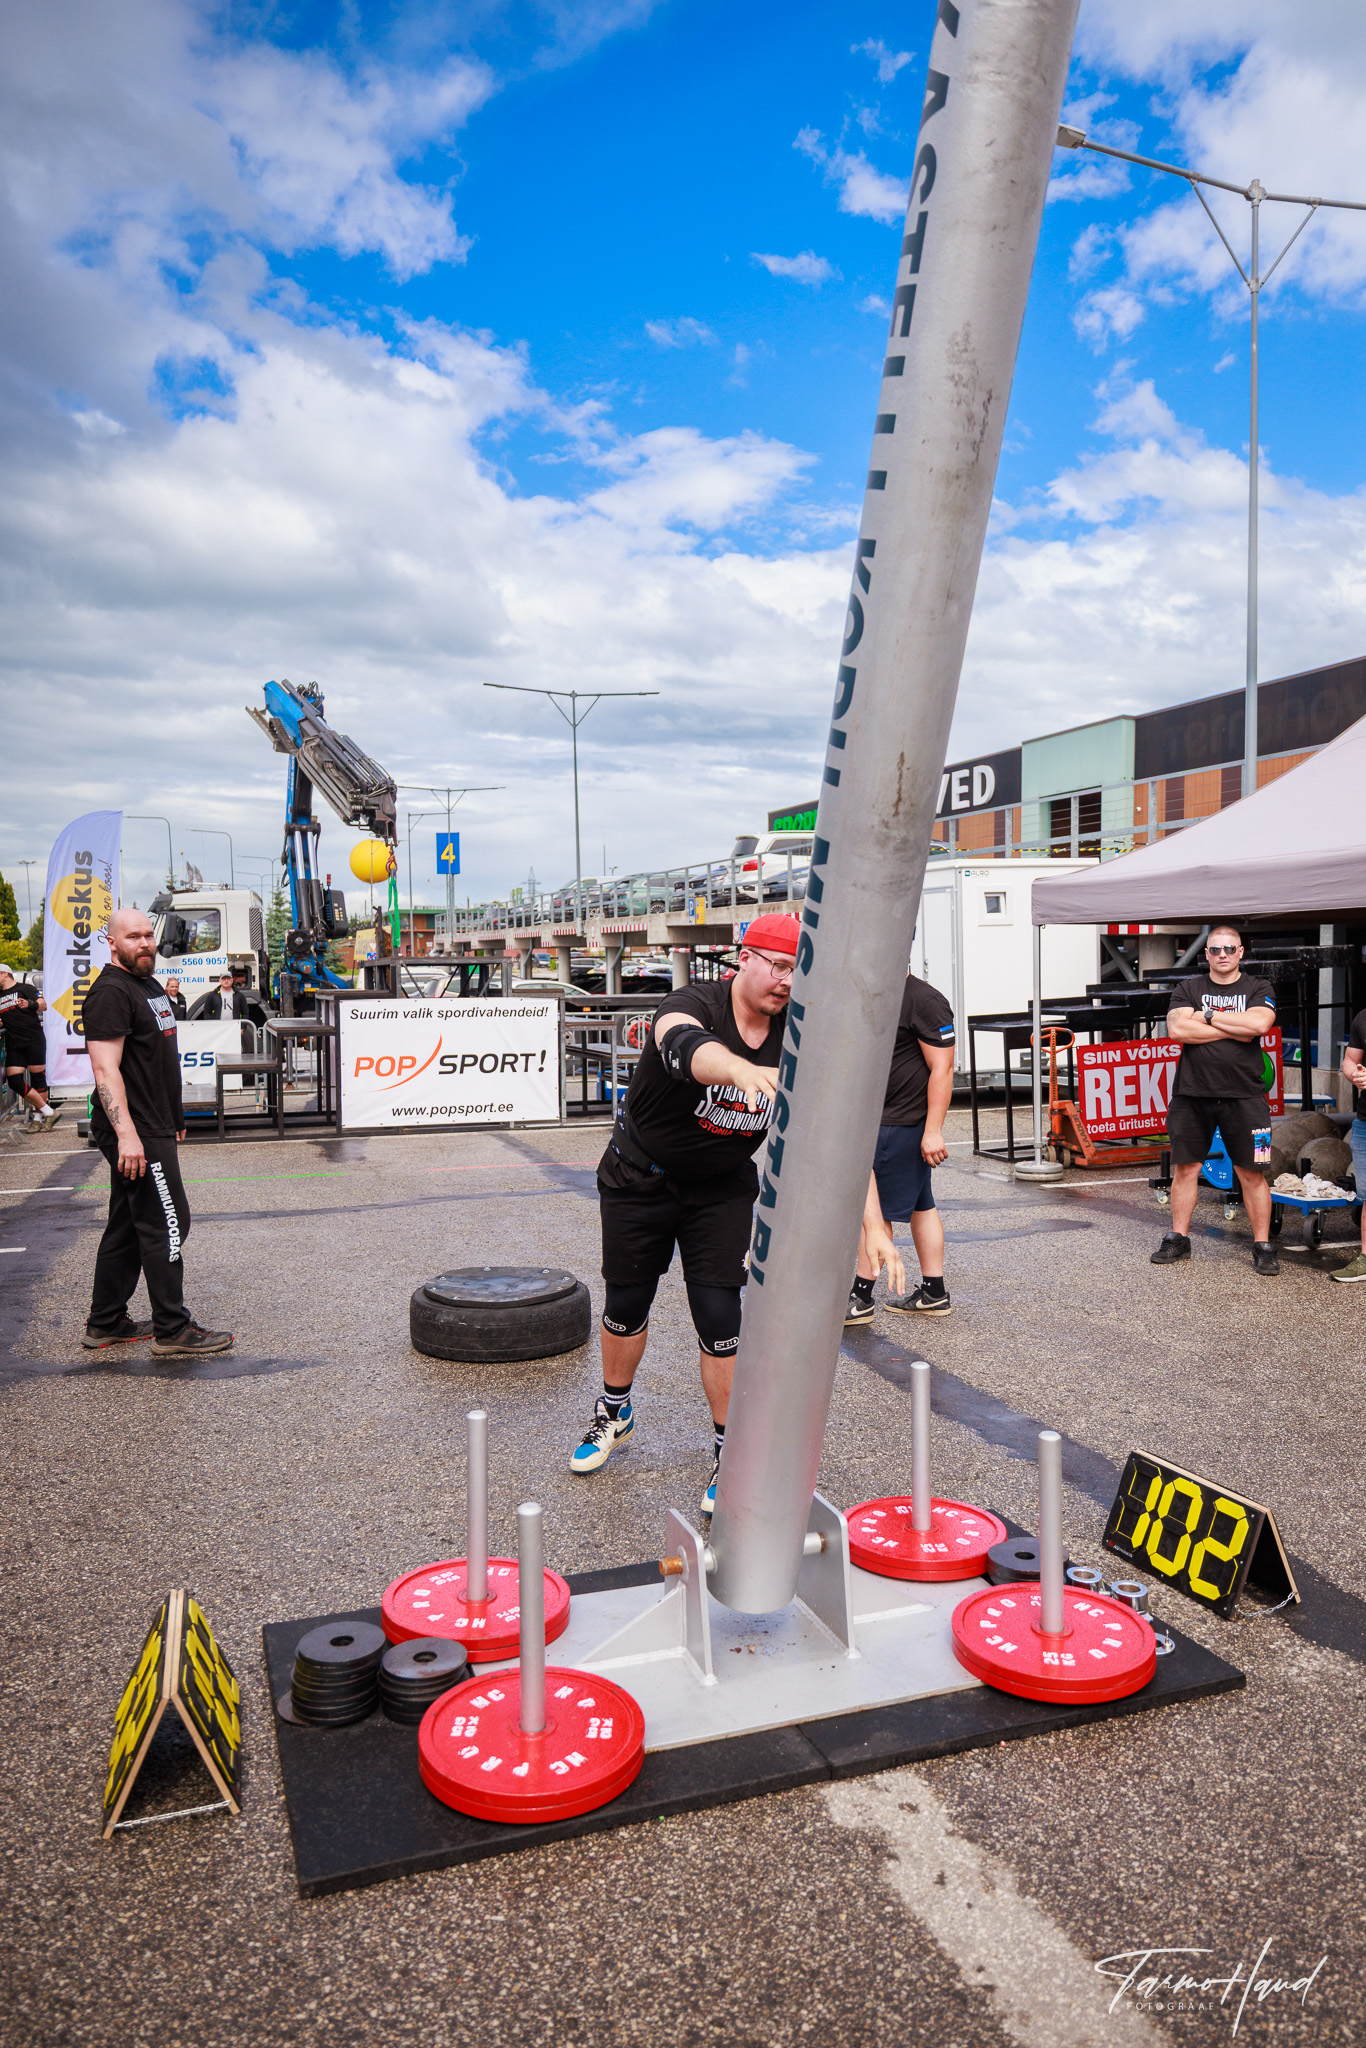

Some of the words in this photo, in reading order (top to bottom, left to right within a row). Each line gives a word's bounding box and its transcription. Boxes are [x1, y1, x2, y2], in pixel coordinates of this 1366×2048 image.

[441, 843, 456, 864] 4
[103, 901, 112, 916] on
[66, 850, 93, 1055] Lõunakeskus
[182, 958, 203, 966] 5560
[205, 957, 227, 965] 9057
[153, 967, 184, 975] GENNO
[350, 1008, 399, 1020] Suurim
[403, 1008, 433, 1019] valik
[437, 1006, 549, 1021] spordivahendeid!
[179, 1051, 215, 1068] SS
[1083, 1049, 1121, 1066] SIIN
[1126, 1044, 1181, 1061] VÕIKS
[354, 1055, 417, 1078] POP
[392, 1102, 514, 1117] www.popsport.ee
[698, 1117, 734, 1136] ESTONIA
[1087, 1121, 1116, 1134] toeta
[1119, 1116, 1158, 1131] üritust:
[150, 1161, 181, 1263] RAMMUKOOBAS
